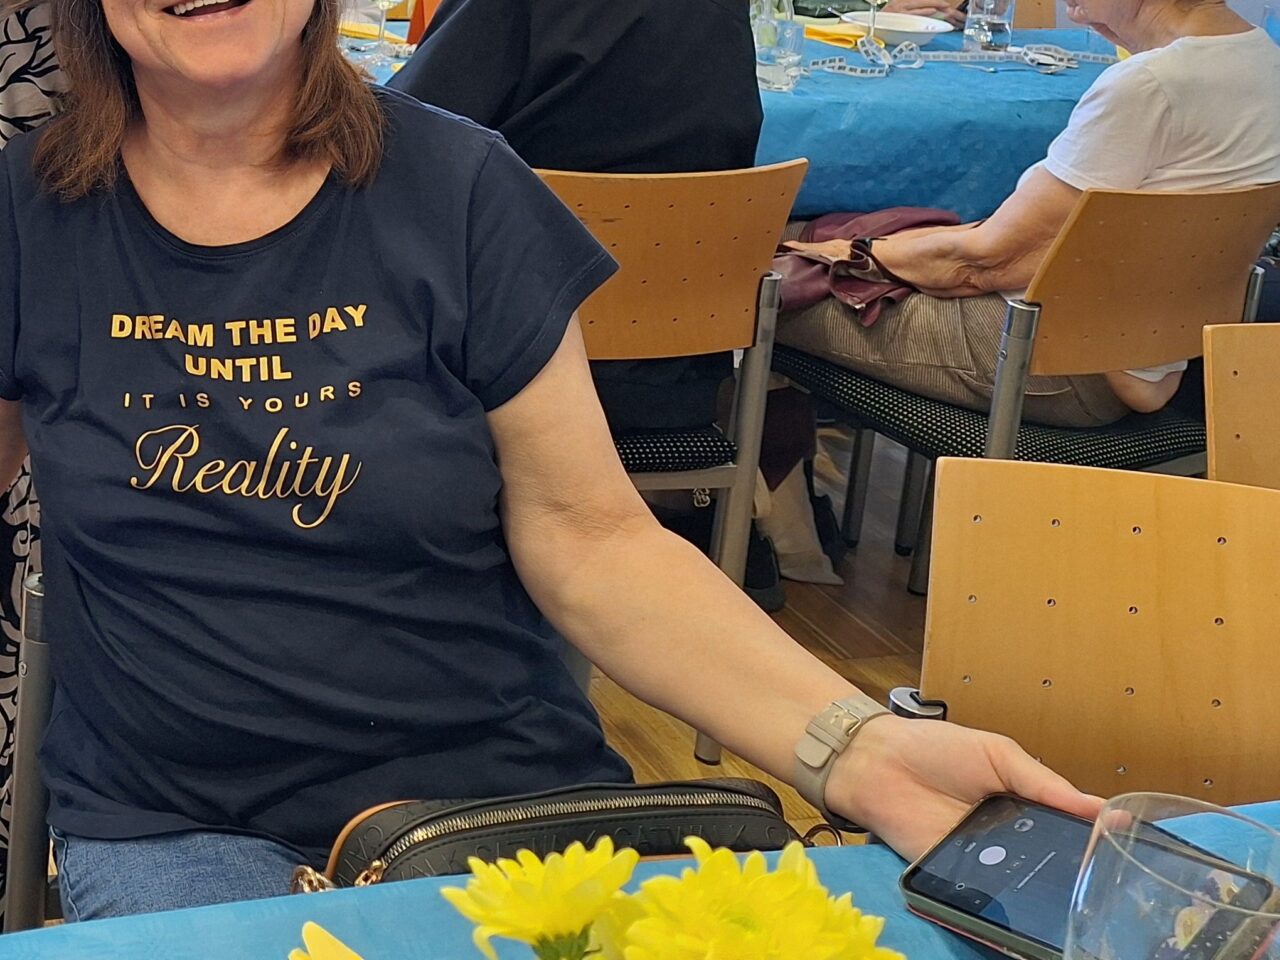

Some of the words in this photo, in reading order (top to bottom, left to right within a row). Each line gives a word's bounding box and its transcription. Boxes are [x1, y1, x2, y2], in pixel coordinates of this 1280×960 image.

[110, 313, 214, 347] DREAM
[225, 318, 297, 347] THE
[308, 304, 367, 340] DAY
[185, 353, 292, 382] UNTIL
[123, 392, 154, 409] IT
[179, 392, 210, 408] IS
[238, 381, 362, 413] YOURS
[130, 424, 362, 528] Reality
